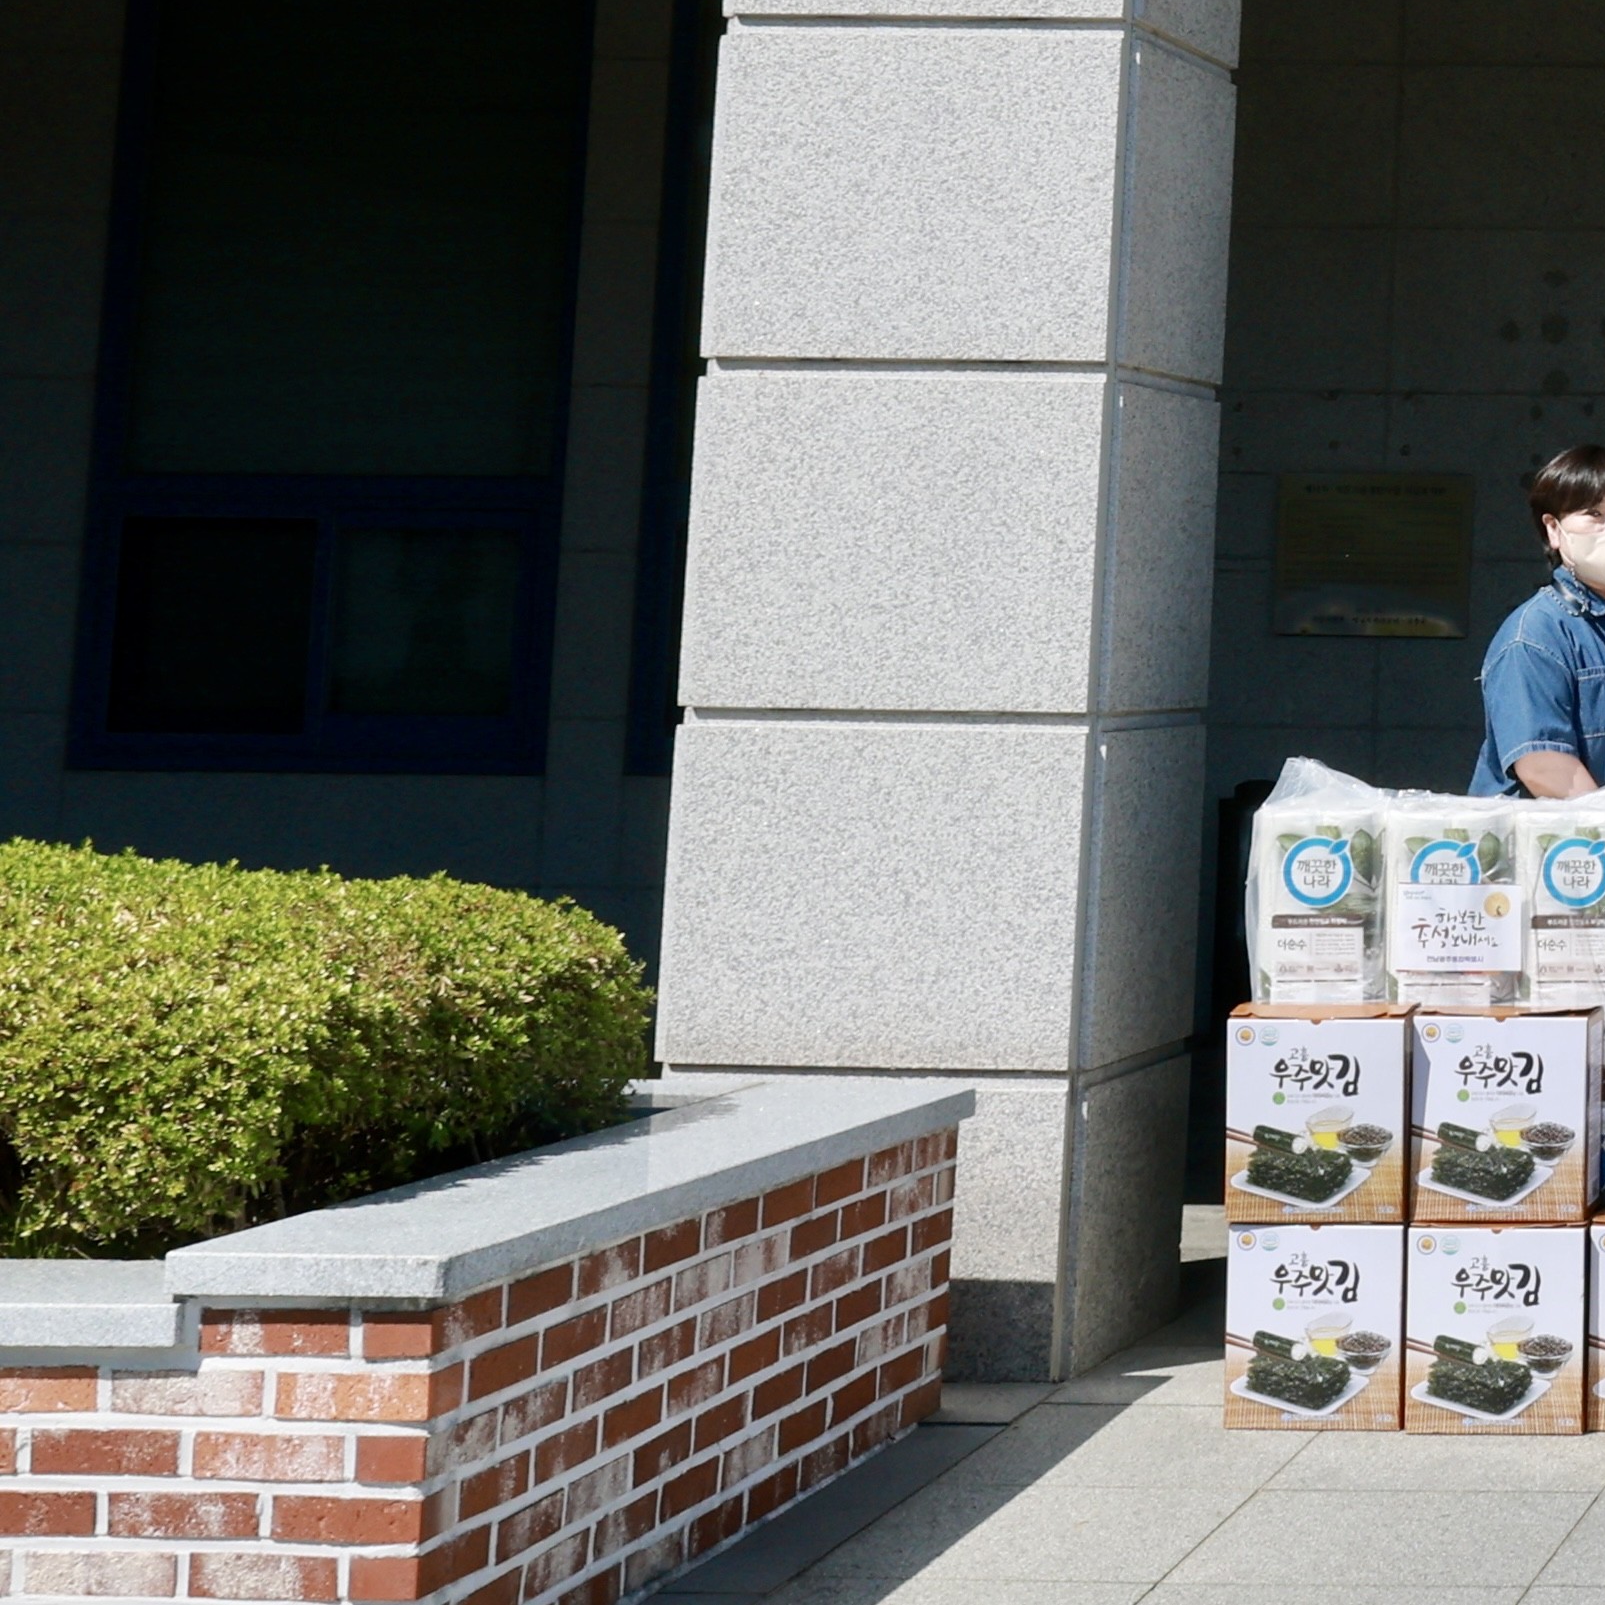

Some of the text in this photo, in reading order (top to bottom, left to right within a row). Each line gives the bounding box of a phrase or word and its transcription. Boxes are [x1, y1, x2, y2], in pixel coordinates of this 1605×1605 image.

[1296, 858, 1337, 876] 깨끗한
[1424, 861, 1466, 878] 깨끗한
[1556, 859, 1597, 876] 깨끗한
[1303, 875, 1332, 890] 나라
[1563, 875, 1591, 890] 나라
[1435, 907, 1486, 931] 행복한
[1277, 938, 1307, 951] 더순수
[1537, 937, 1567, 952] 더순수
[1289, 1046, 1309, 1062] 고흥
[1474, 1044, 1494, 1061] 고흥
[1269, 1051, 1361, 1097] 우주맛김
[1454, 1049, 1545, 1096] 우주맛김
[1290, 1251, 1310, 1267] 고흥
[1470, 1255, 1490, 1271] 고흥
[1269, 1259, 1361, 1304] 우주맛김
[1450, 1263, 1542, 1307] 우주맛김
